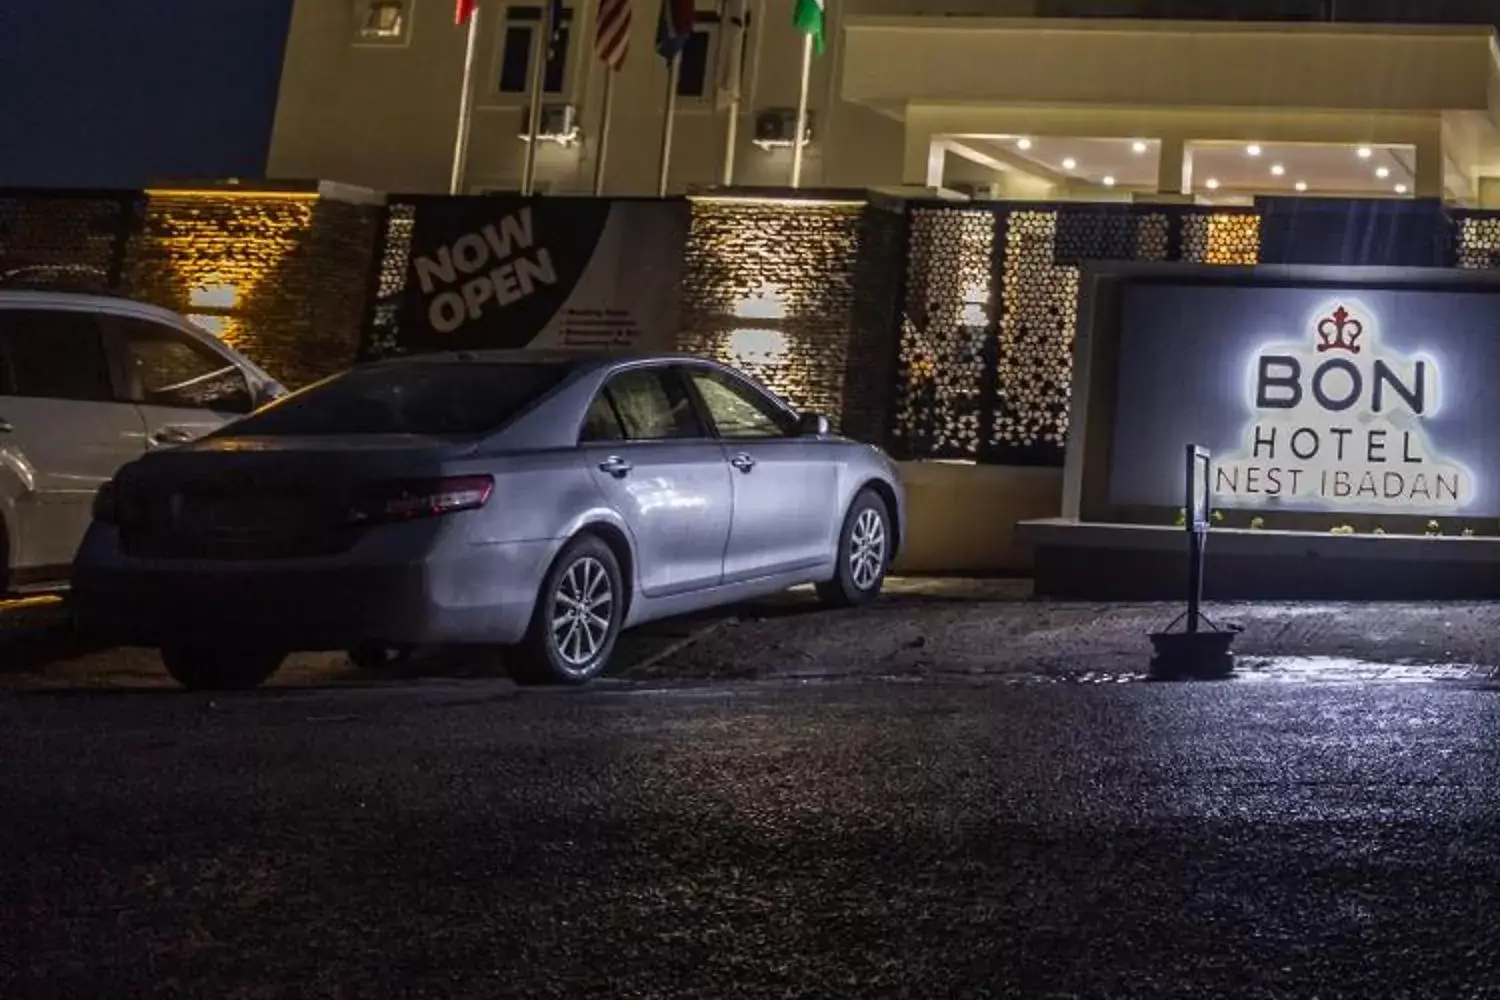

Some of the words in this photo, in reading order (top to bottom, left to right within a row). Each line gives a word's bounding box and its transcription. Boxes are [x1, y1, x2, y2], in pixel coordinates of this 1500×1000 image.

[413, 206, 534, 295] NOW
[429, 248, 557, 333] OPEN
[1256, 355, 1426, 415] BON
[1253, 425, 1423, 464] HOTEL
[1215, 466, 1304, 496] NEST
[1320, 469, 1458, 500] IBADAN
